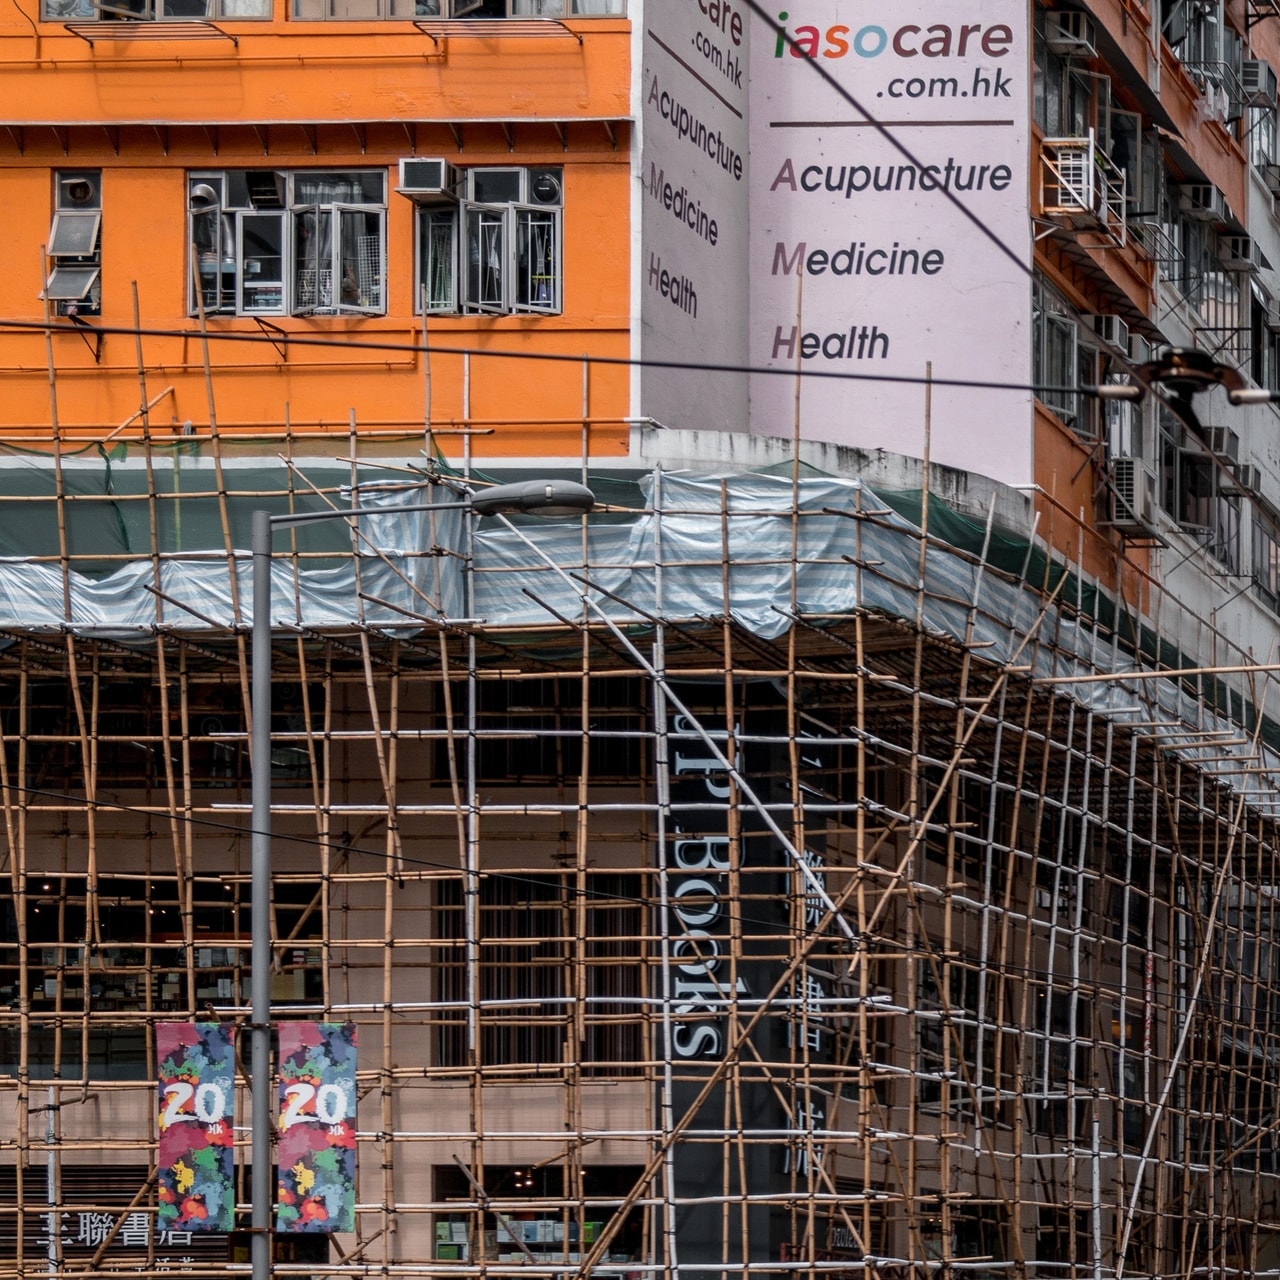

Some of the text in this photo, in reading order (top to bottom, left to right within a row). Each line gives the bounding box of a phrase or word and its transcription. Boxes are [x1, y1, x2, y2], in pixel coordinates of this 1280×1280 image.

[775, 13, 1013, 59] iasocare
[691, 31, 742, 90] .com.hk
[876, 68, 1012, 99] .com.hk
[648, 74, 743, 182] Acupuncture
[770, 157, 1012, 198] Acupuncture
[650, 161, 718, 246] Medicine
[771, 241, 944, 276] Medicine
[649, 251, 698, 318] Health
[771, 326, 889, 360] Health
[164, 1083, 225, 1126] 20
[283, 1084, 347, 1127] 20
